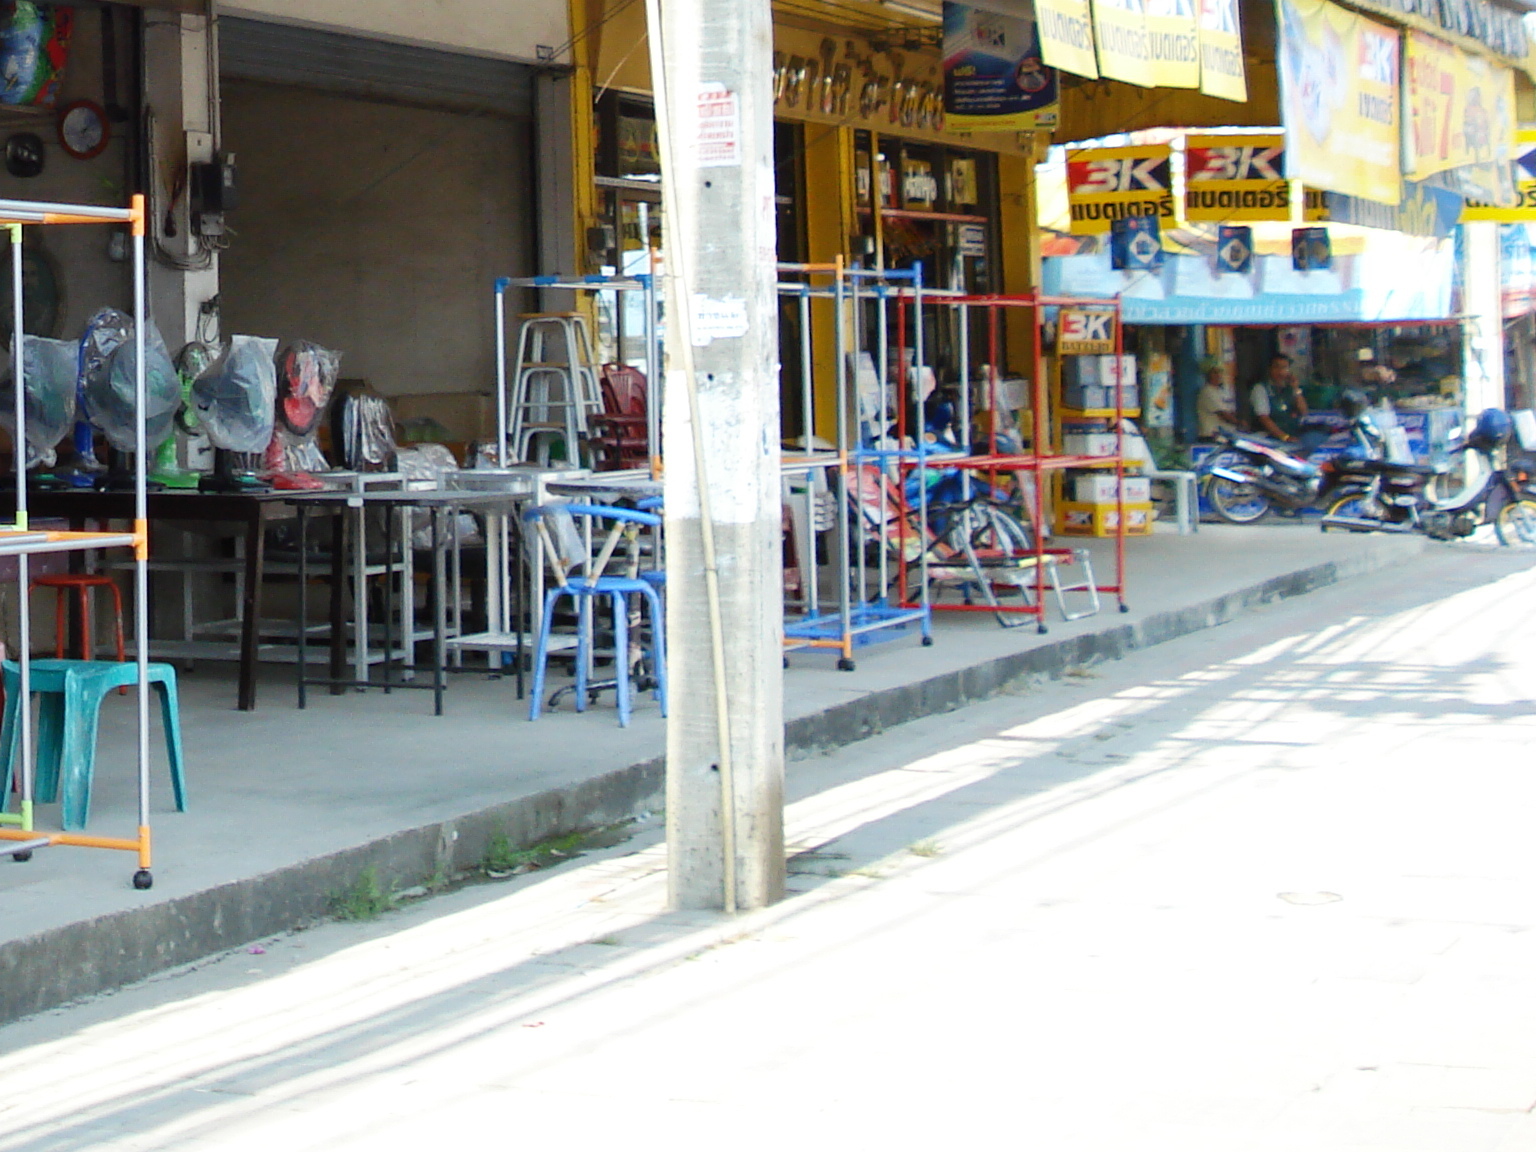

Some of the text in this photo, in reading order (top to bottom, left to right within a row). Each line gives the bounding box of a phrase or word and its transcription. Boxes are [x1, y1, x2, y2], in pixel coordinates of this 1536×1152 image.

[1073, 156, 1169, 195] 3K
[1190, 145, 1286, 182] 3K
[1061, 313, 1110, 341] 3K
